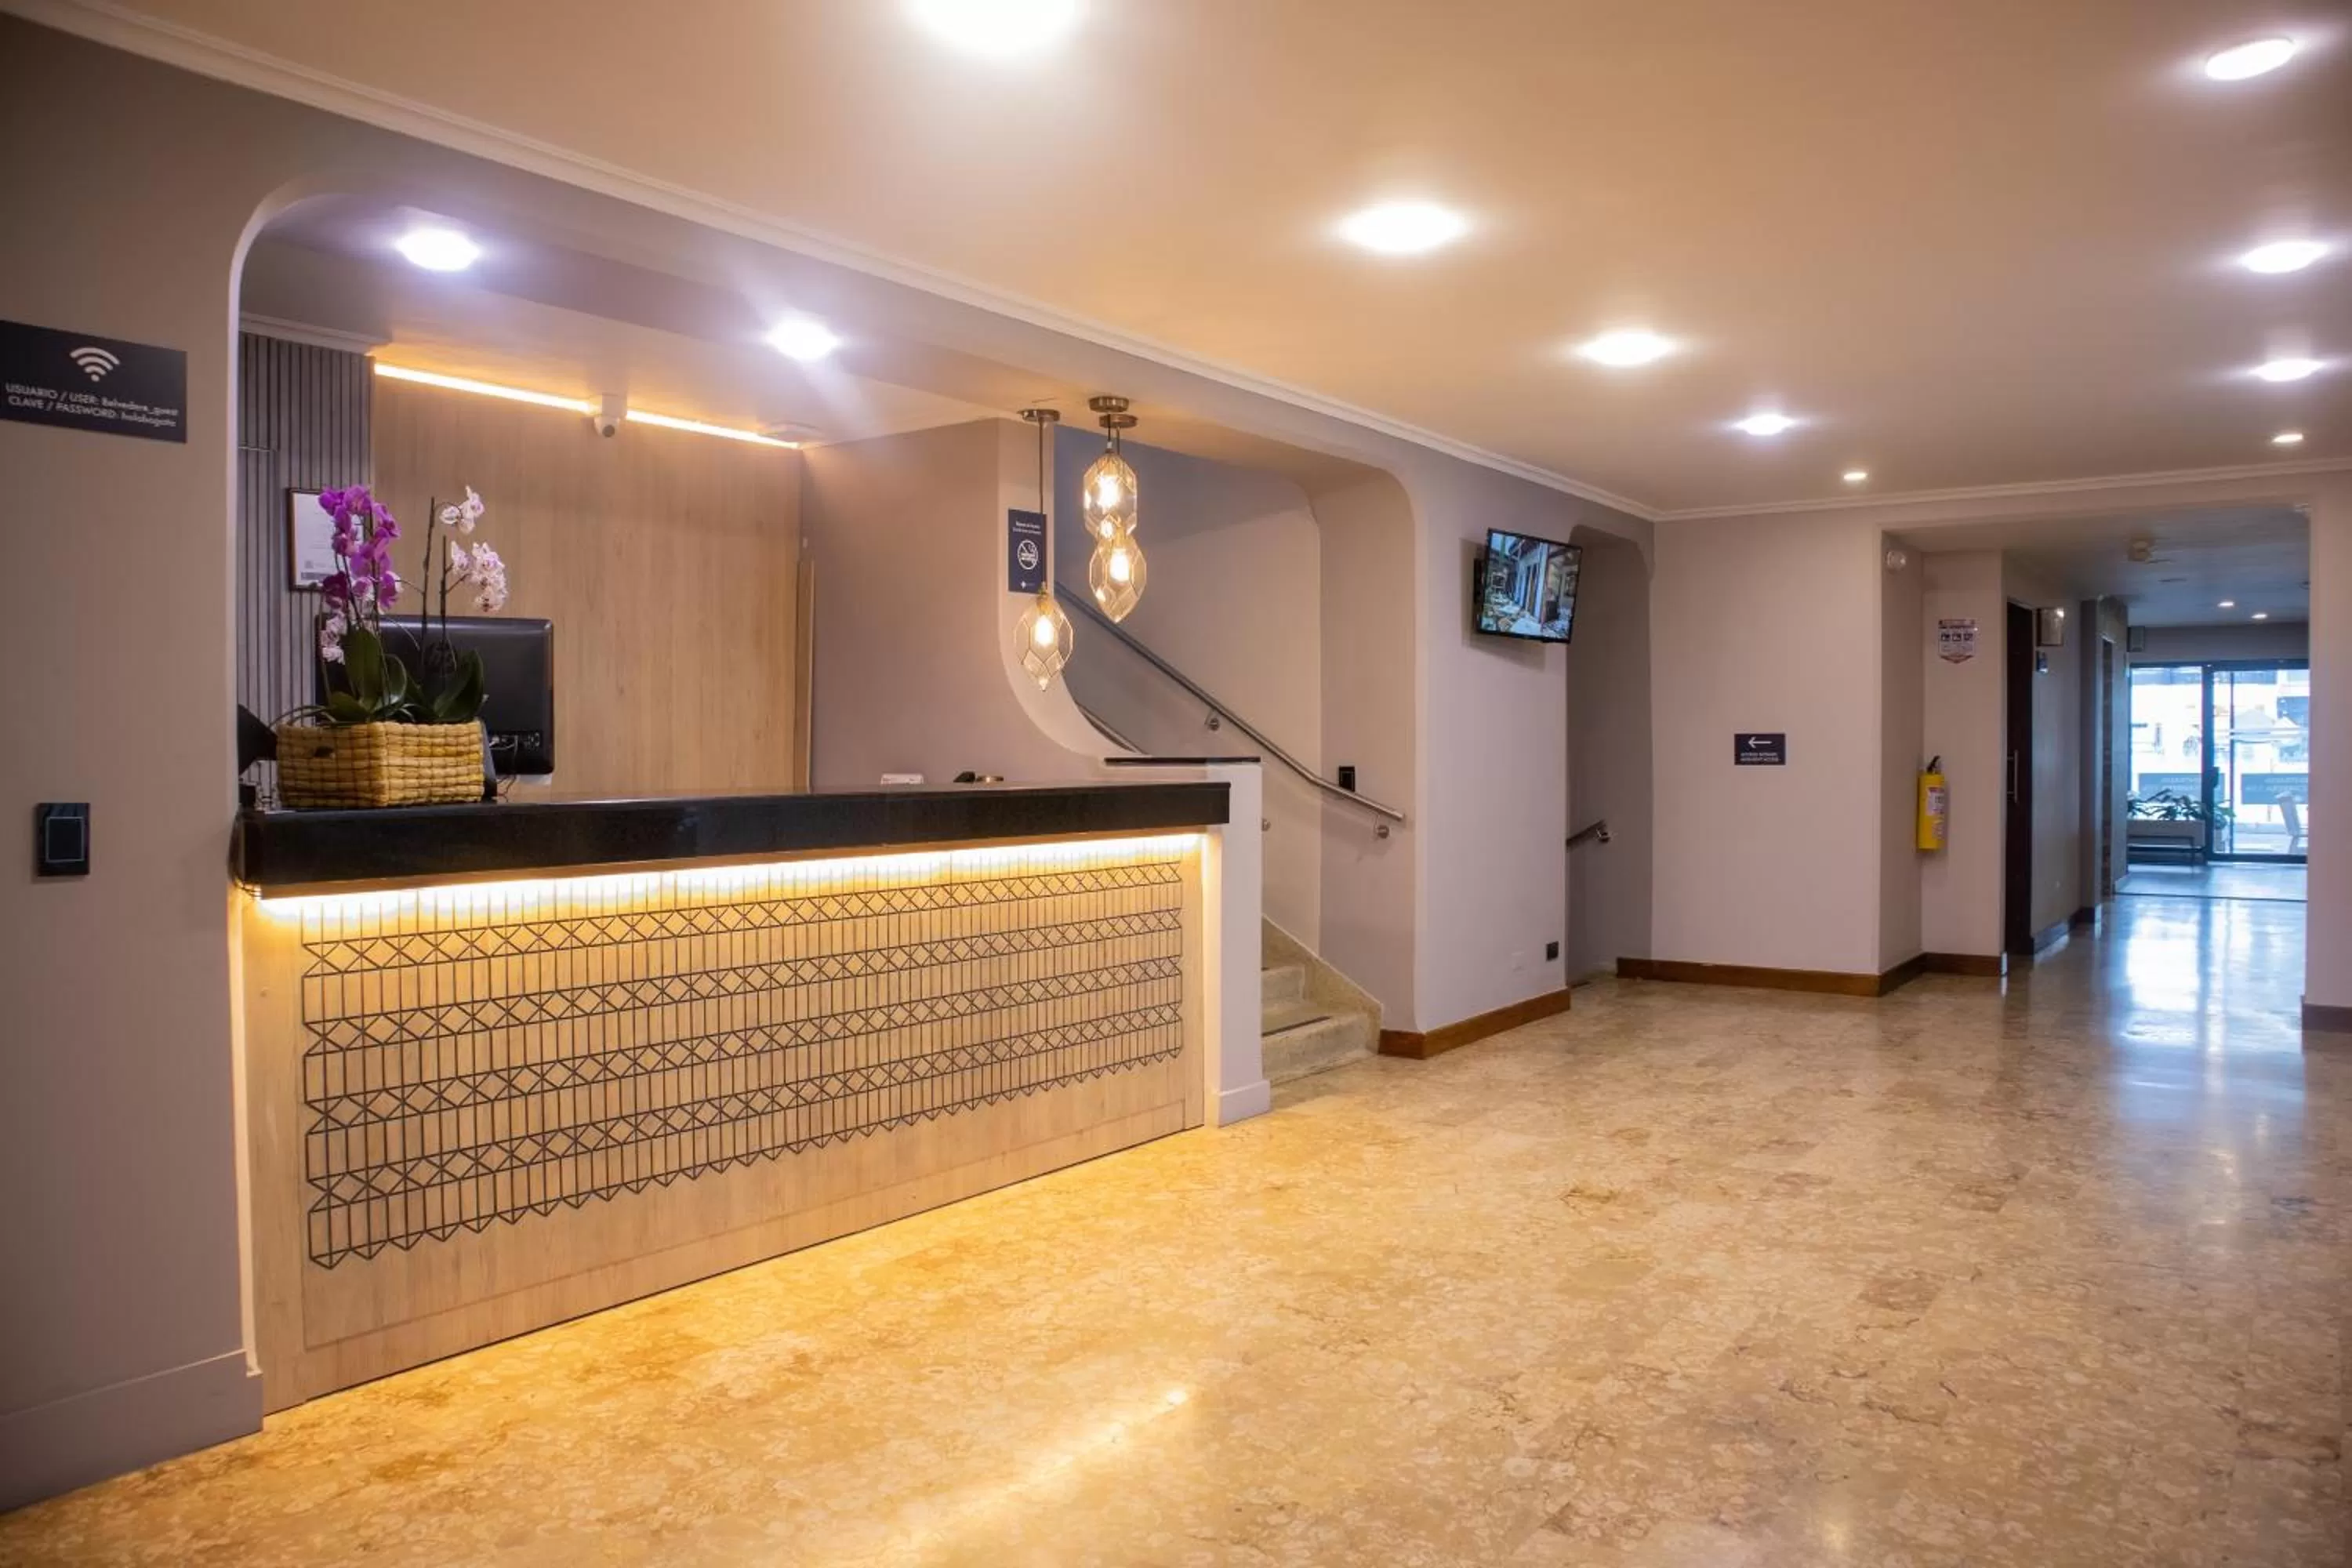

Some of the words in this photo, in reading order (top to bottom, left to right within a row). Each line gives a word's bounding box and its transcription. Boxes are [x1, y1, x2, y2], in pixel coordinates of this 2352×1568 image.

[5, 383, 58, 399] USUARIO
[61, 391, 67, 401] /
[69, 392, 100, 405] USER:
[9, 395, 45, 409] CLAVE
[47, 401, 53, 412] /
